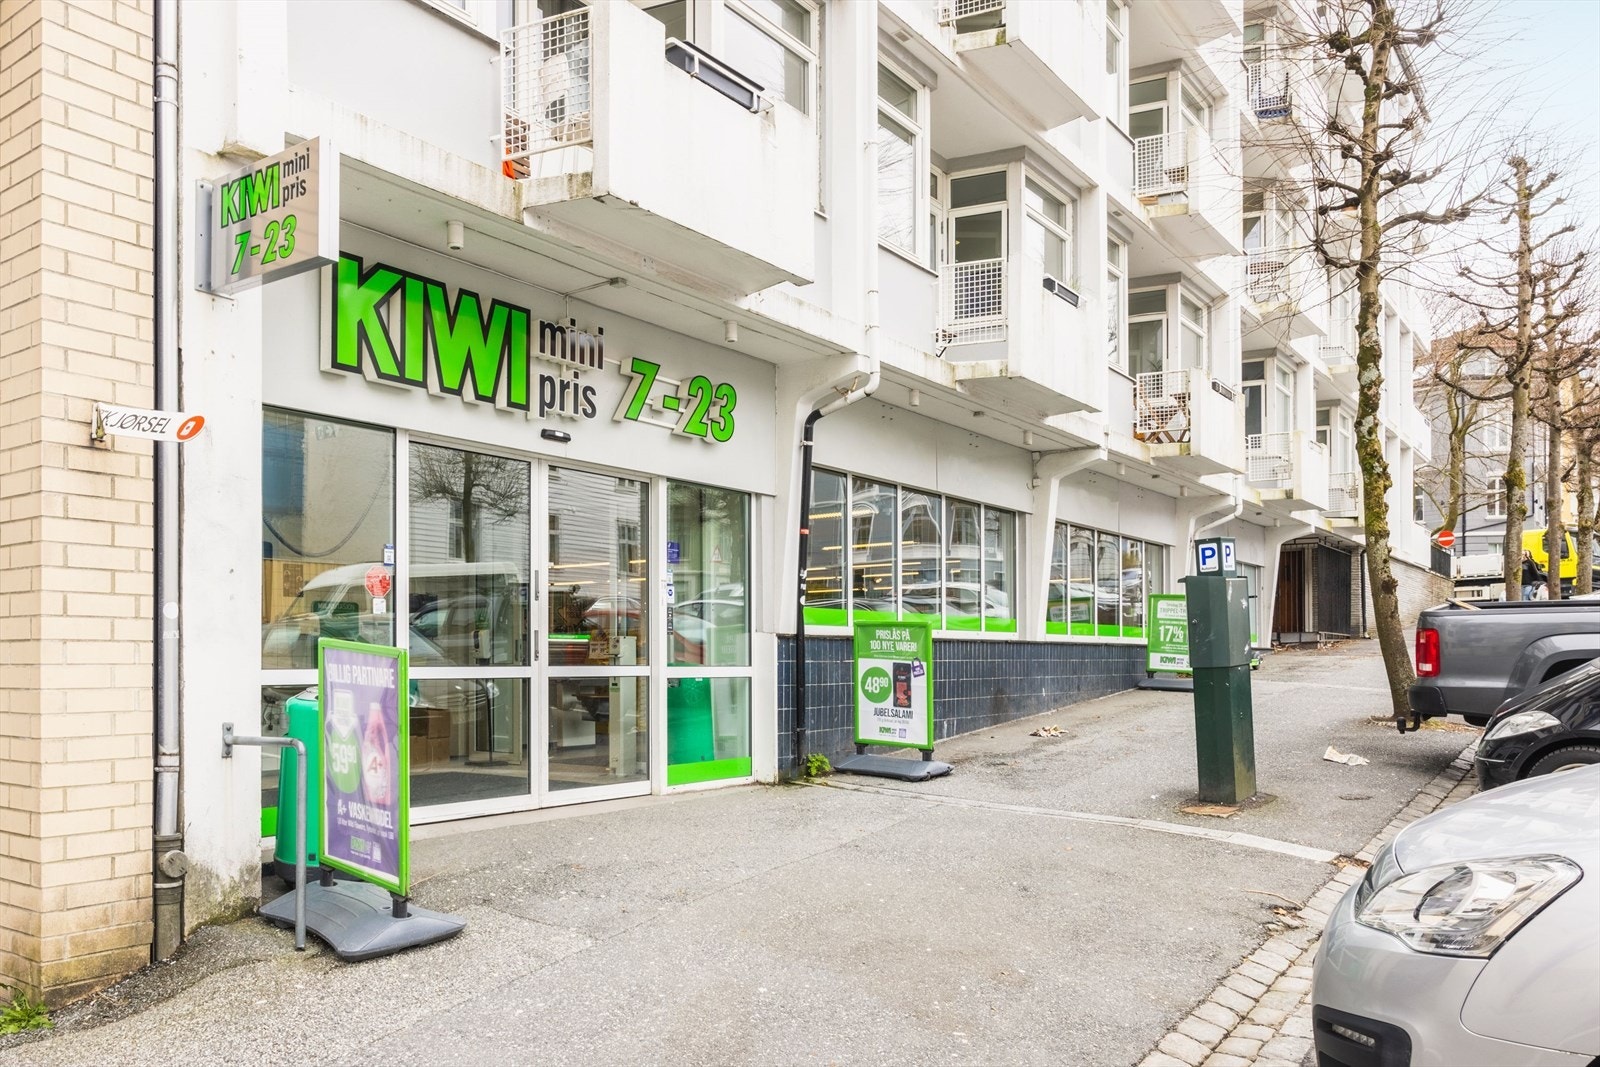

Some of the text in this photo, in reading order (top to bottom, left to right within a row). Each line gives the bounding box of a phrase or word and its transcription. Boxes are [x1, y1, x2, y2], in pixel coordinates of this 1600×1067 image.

[220, 147, 311, 229] KIWI mini
[282, 176, 307, 207] pris
[331, 251, 605, 412] KIWI mini
[538, 370, 598, 419] pris
[101, 410, 172, 434] KJØRSEL
[1201, 547, 1216, 566] P
[1225, 545, 1231, 563] P
[875, 627, 911, 641] PRISLÅS PÅ
[1158, 625, 1184, 642] 17%
[869, 640, 918, 652] 100 NYE VARER!
[328, 662, 351, 684] BILLIG
[873, 707, 914, 719] JUBELSALAMI
[337, 799, 347, 816] A+
